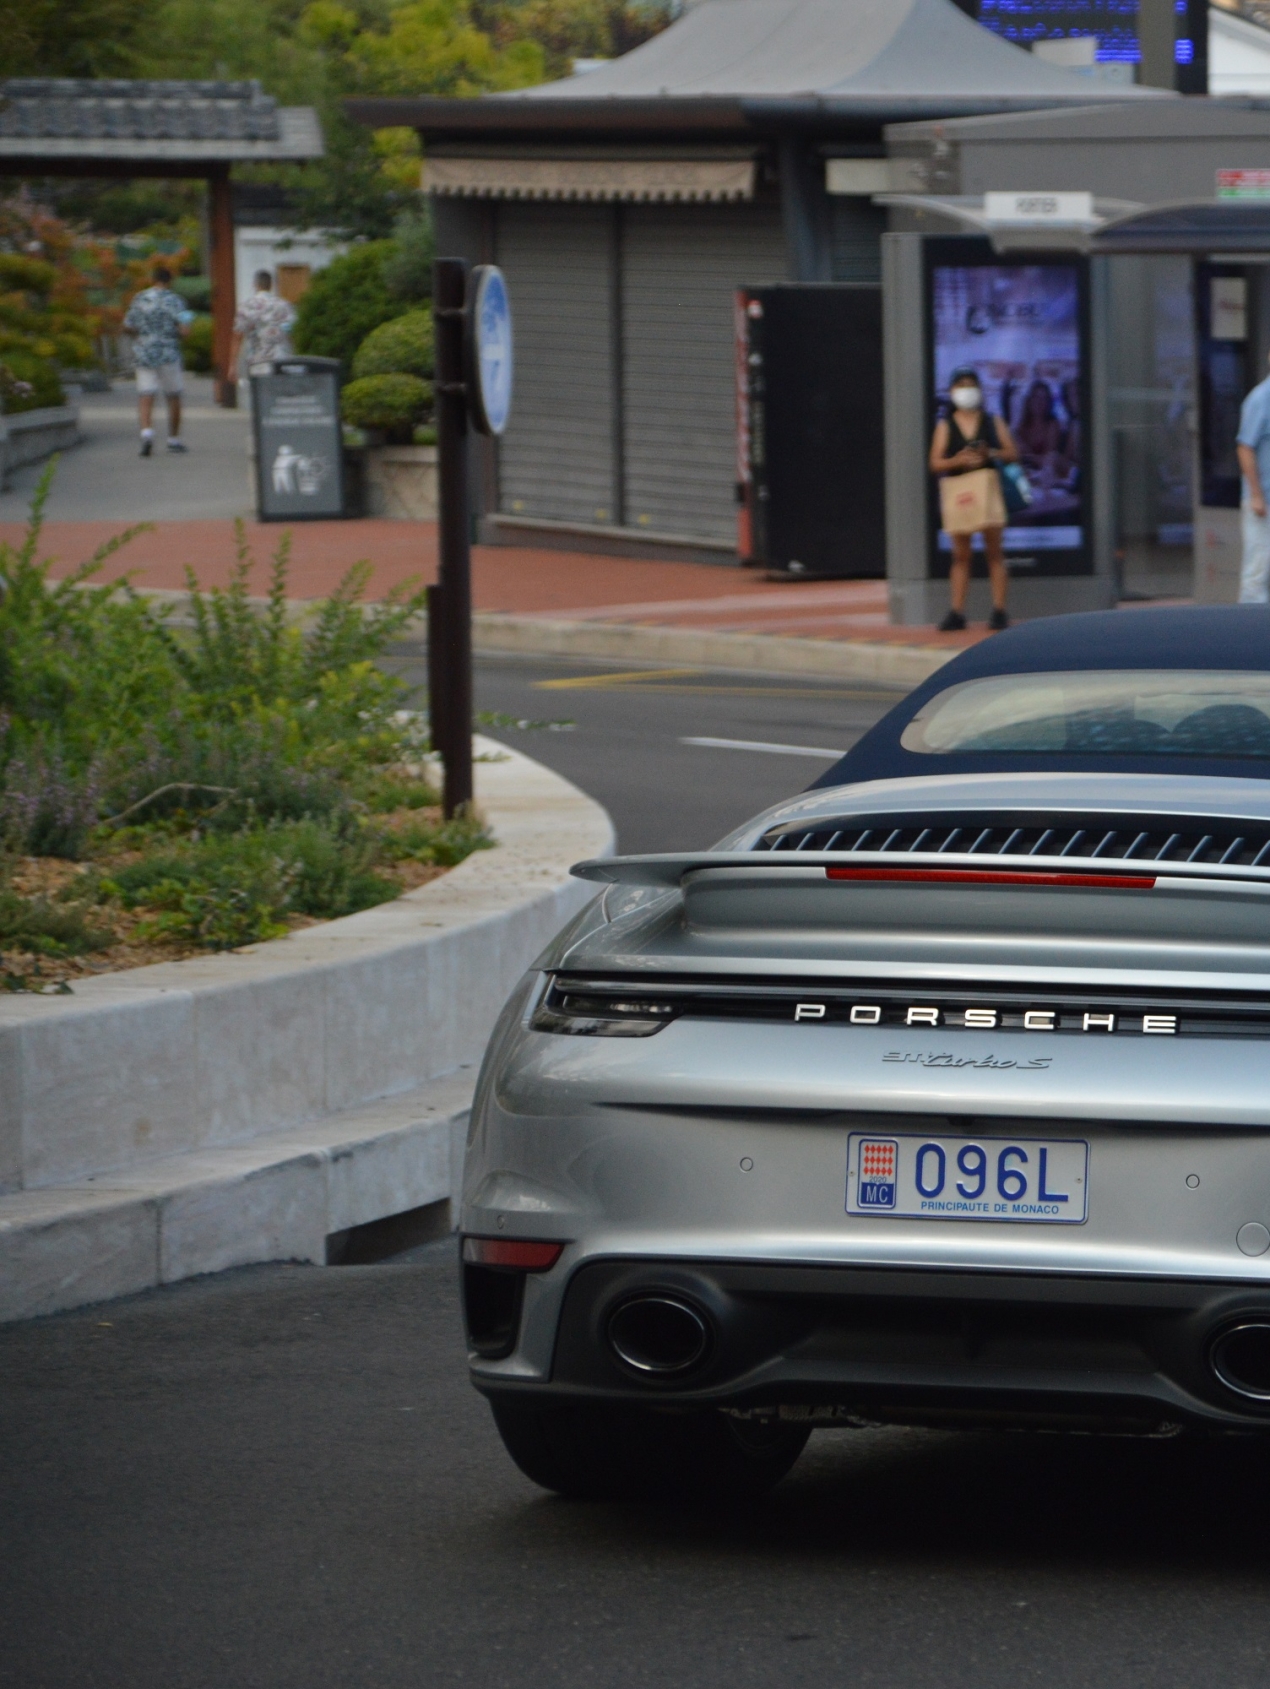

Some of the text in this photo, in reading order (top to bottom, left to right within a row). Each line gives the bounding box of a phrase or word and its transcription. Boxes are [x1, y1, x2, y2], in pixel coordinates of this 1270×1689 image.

[794, 1003, 1177, 1034] PORSCHE
[915, 1142, 1069, 1202] 096L
[866, 1185, 889, 1203] MC
[920, 1201, 1059, 1215] PRINCIPAUTE DE MONACO
